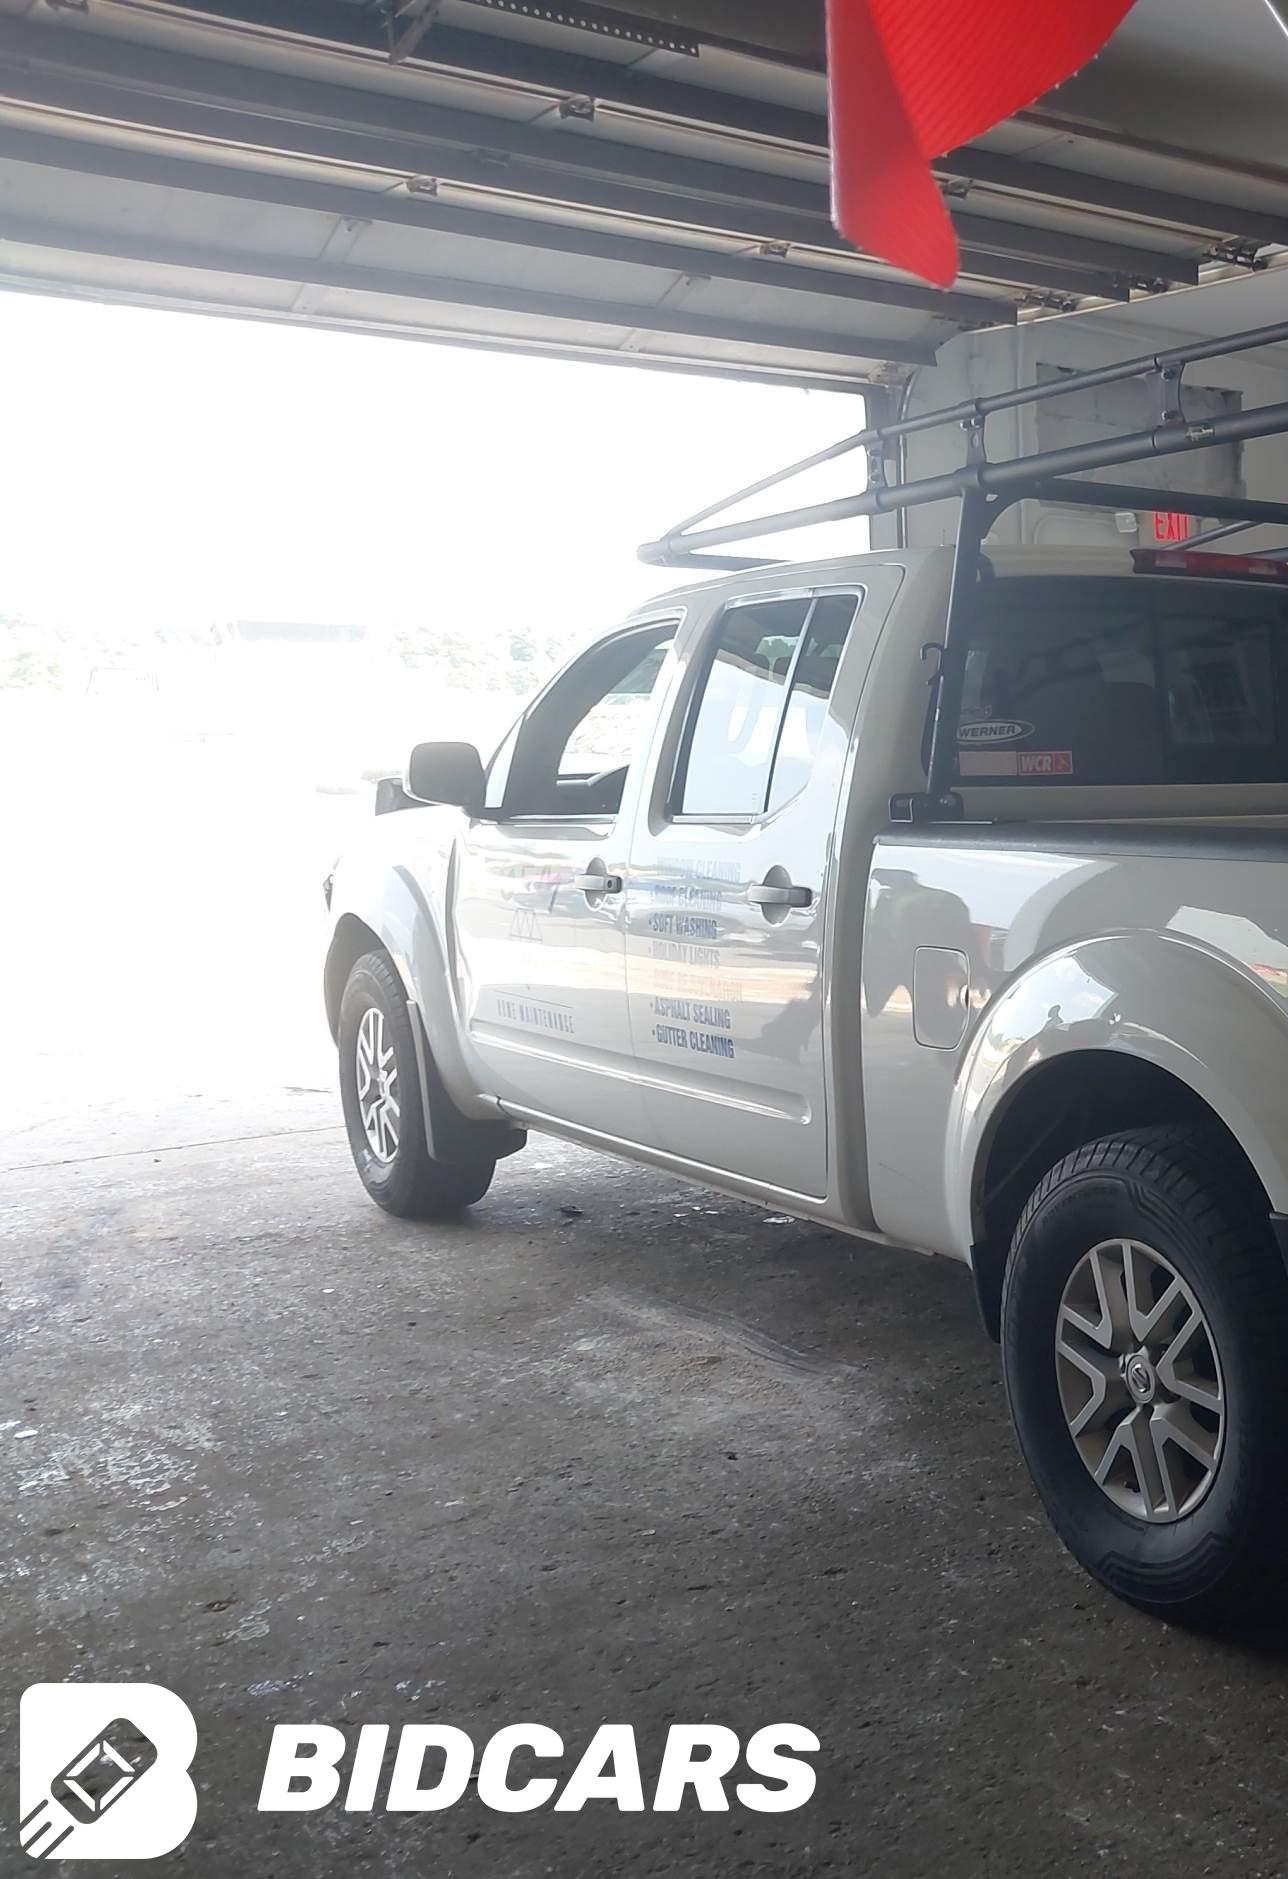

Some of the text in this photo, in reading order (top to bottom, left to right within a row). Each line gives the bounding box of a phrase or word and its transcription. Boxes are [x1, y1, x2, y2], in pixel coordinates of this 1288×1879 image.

[1155, 512, 1189, 541] EXIT
[959, 725, 1016, 738] WERNER
[1021, 754, 1052, 772] WCR
[653, 912, 719, 940] SOFT WASHING
[655, 996, 732, 1030] ASPHALT SEALING
[656, 1023, 736, 1059] GUTTER CLEANING
